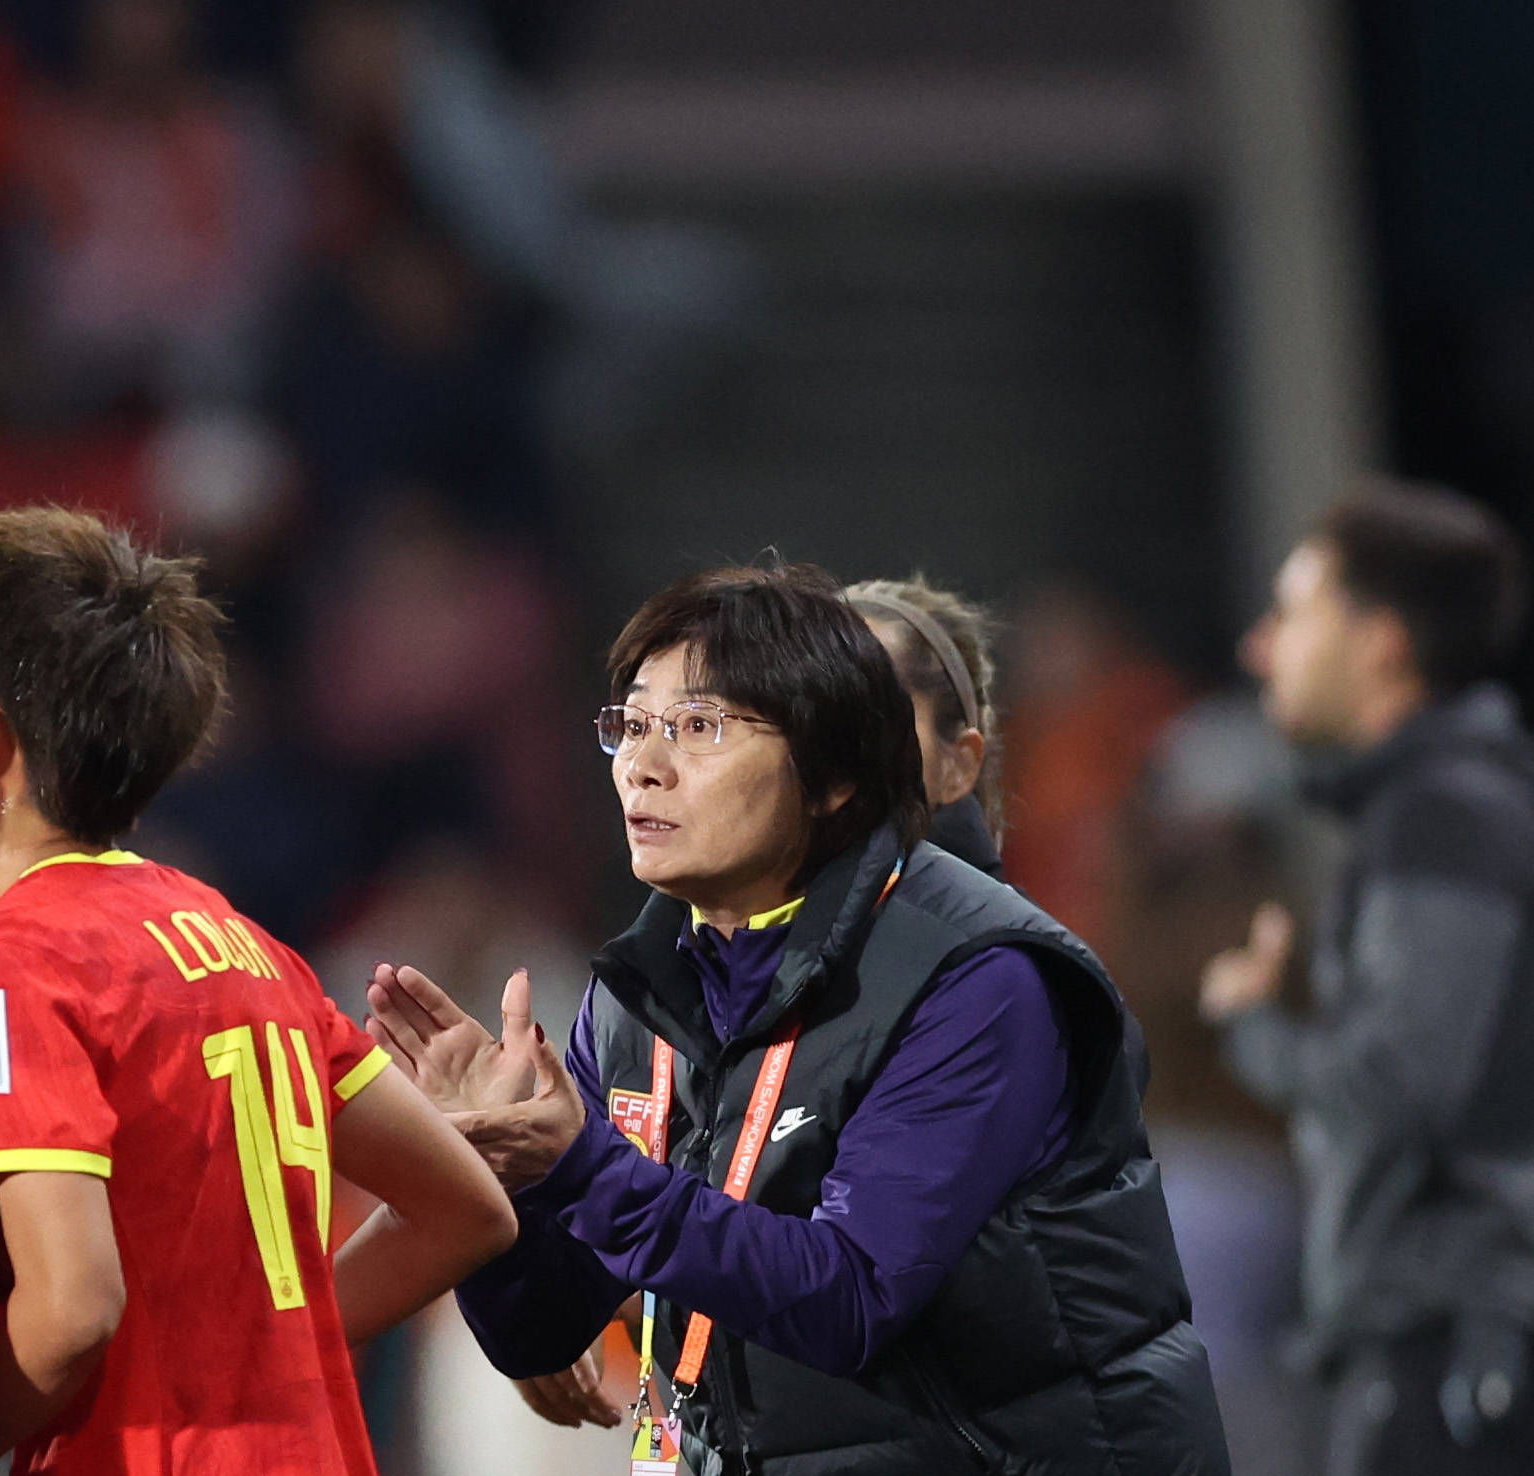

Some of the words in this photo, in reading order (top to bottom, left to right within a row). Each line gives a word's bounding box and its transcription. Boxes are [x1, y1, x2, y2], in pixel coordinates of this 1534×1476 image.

[201, 1020, 331, 1311] 14
[623, 1119, 643, 1133] 中国
[733, 1155, 751, 1187] FIFA
[745, 1086, 774, 1157] WOMEN'S
[767, 1041, 787, 1086] WORL
